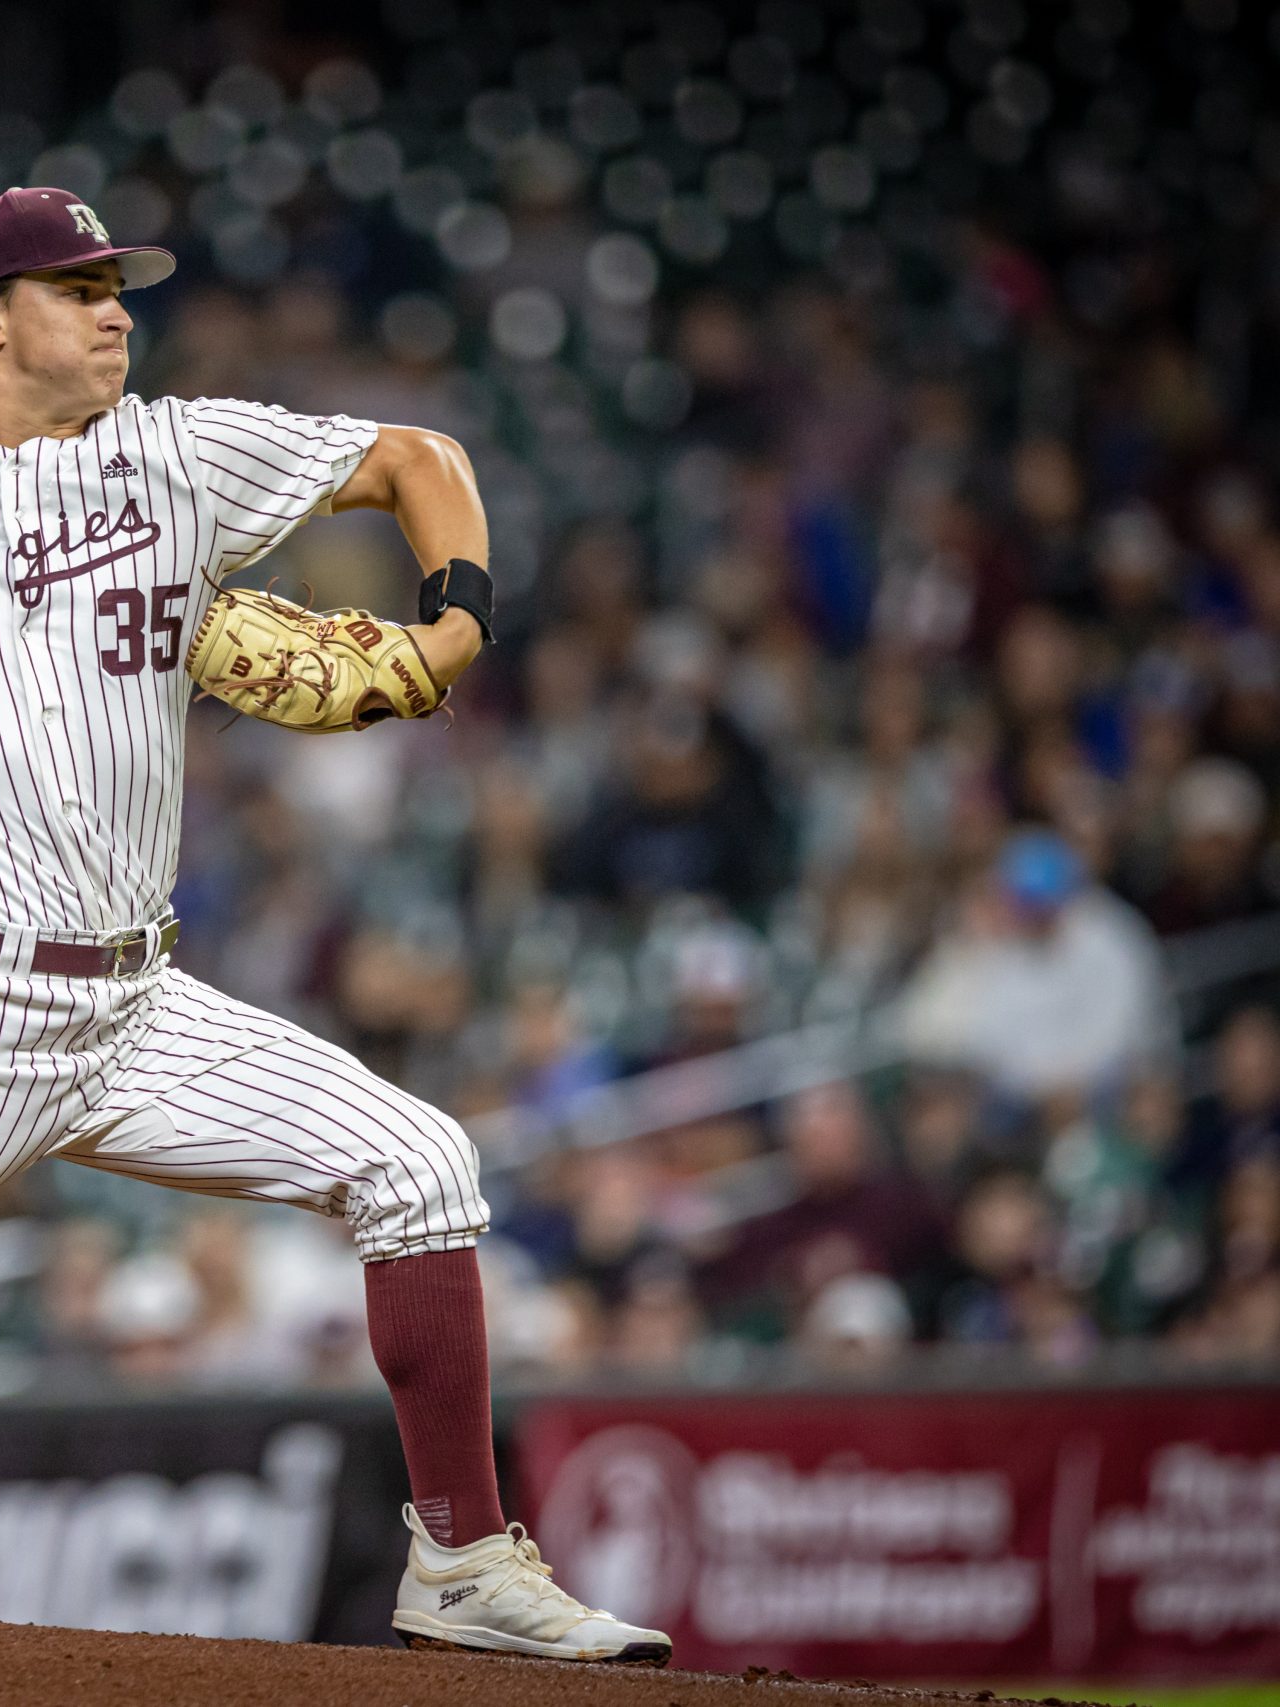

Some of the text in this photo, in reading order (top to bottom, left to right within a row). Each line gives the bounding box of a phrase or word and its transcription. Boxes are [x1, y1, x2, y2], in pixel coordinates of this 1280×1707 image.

[102, 468, 138, 479] adidas
[98, 583, 190, 677] 35
[390, 657, 427, 713] Wilson
[439, 1584, 478, 1609] Aggies
